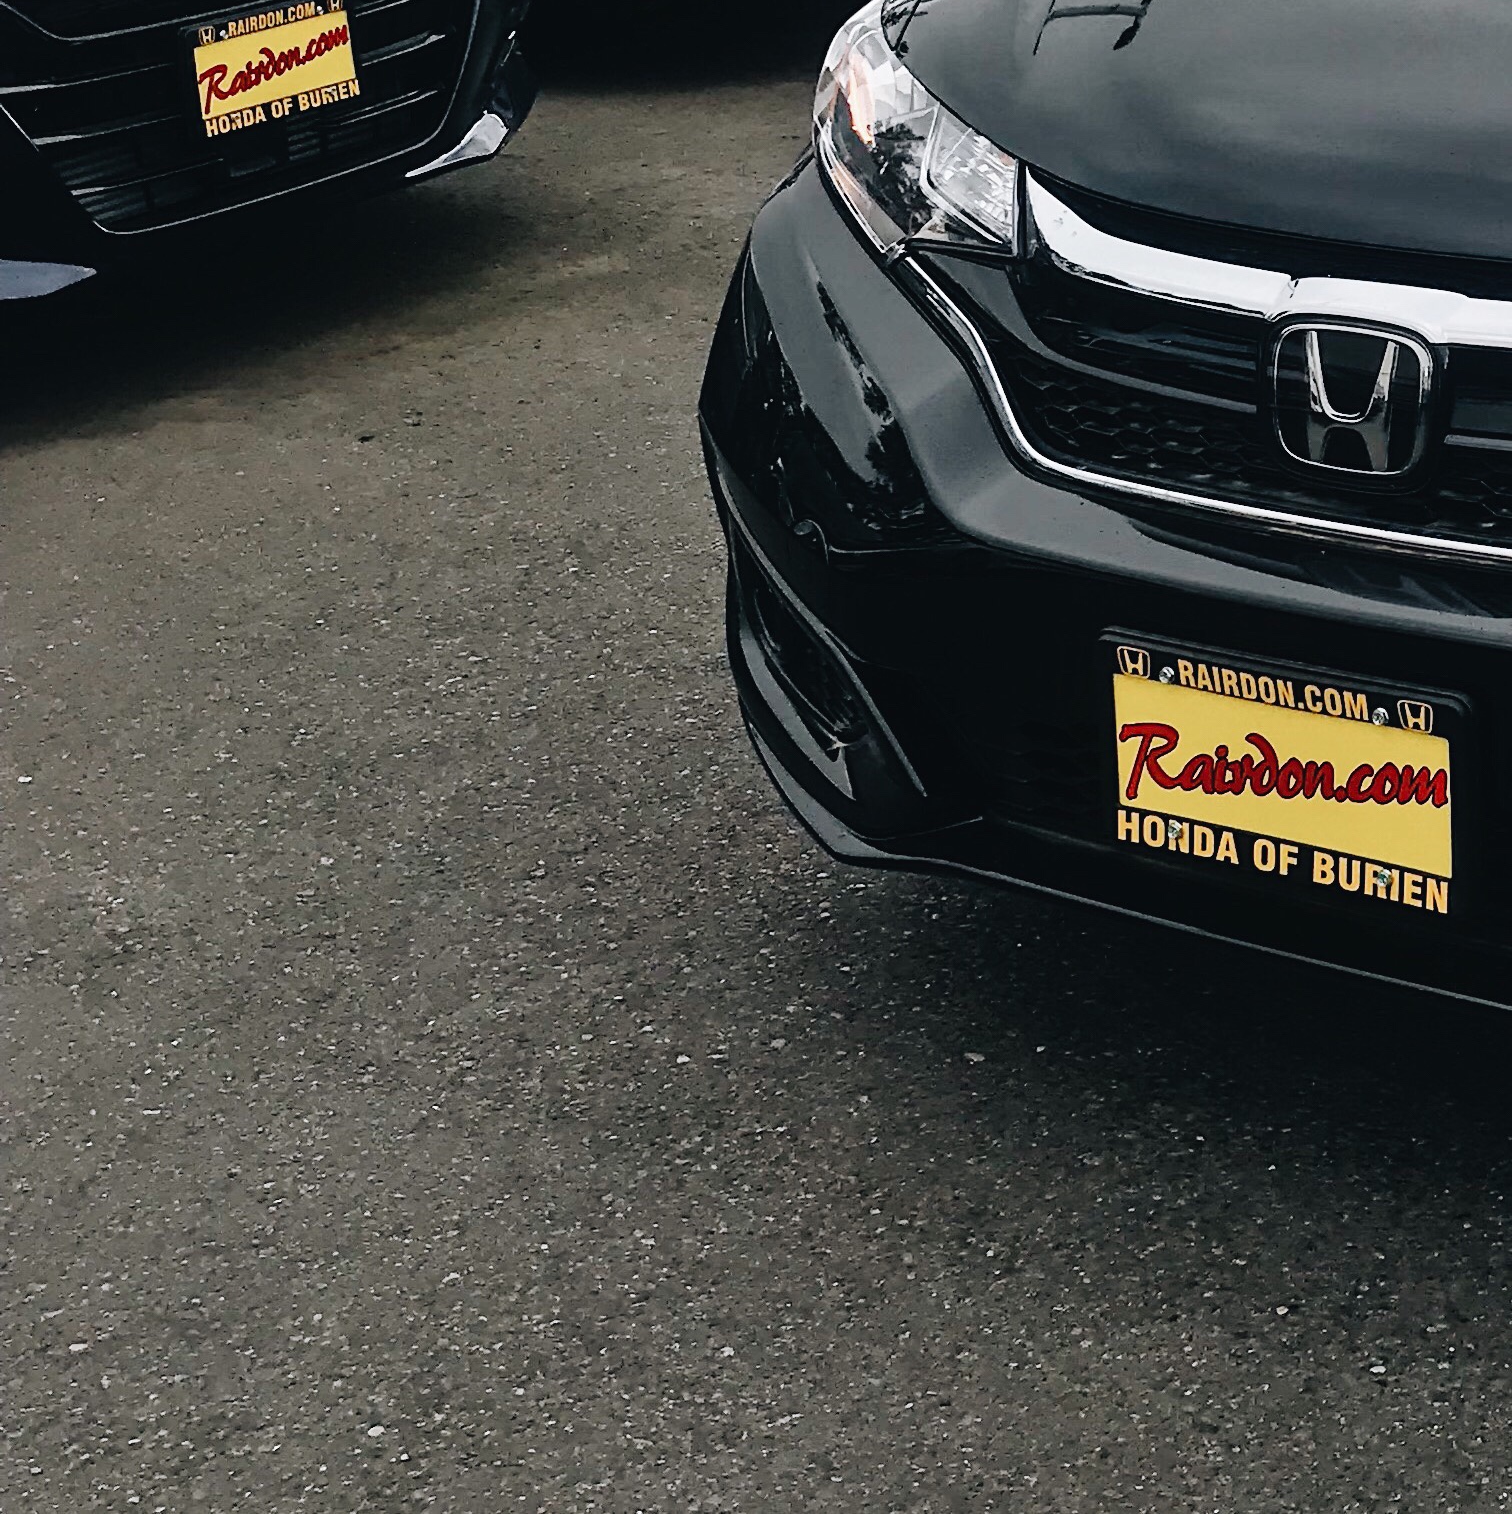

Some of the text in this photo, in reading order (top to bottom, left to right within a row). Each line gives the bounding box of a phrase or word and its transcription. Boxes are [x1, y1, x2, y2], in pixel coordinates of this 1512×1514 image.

[228, 1, 316, 37] RAIRDON.COM
[199, 24, 350, 114] Rairdon.com
[205, 79, 361, 137] HONDA OF BURIEN
[1178, 658, 1369, 722] RAIRDON.COM
[1118, 722, 1450, 808] Rairdon.com
[1117, 809, 1449, 914] HONDA OF BURIEN
